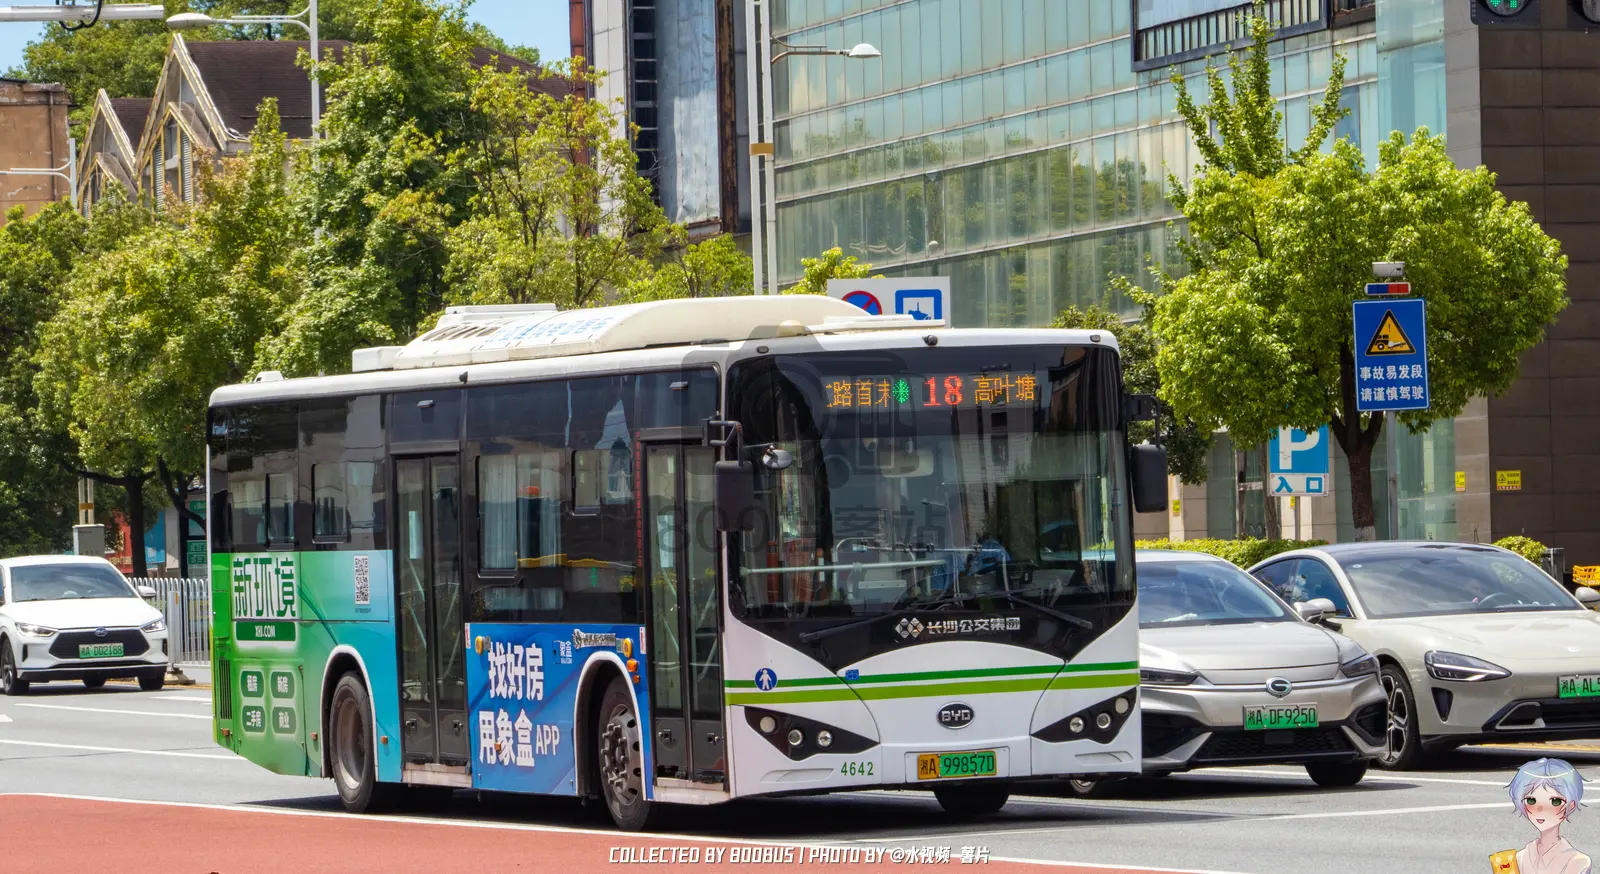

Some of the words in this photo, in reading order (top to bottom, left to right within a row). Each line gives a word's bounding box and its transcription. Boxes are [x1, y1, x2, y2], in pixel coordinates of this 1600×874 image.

[1360, 364, 1423, 381] 事故易发段
[924, 375, 963, 406] 18
[973, 373, 1036, 405] 高叶塘
[1361, 385, 1424, 402] 请谨慎驾驶
[1279, 424, 1320, 470] P
[1275, 476, 1323, 493] 入口
[233, 557, 296, 617] 新环境
[927, 617, 1020, 635] 长沙公交集团
[488, 642, 544, 700] 找好房
[941, 709, 971, 722] BYD
[841, 762, 874, 776] 4642
